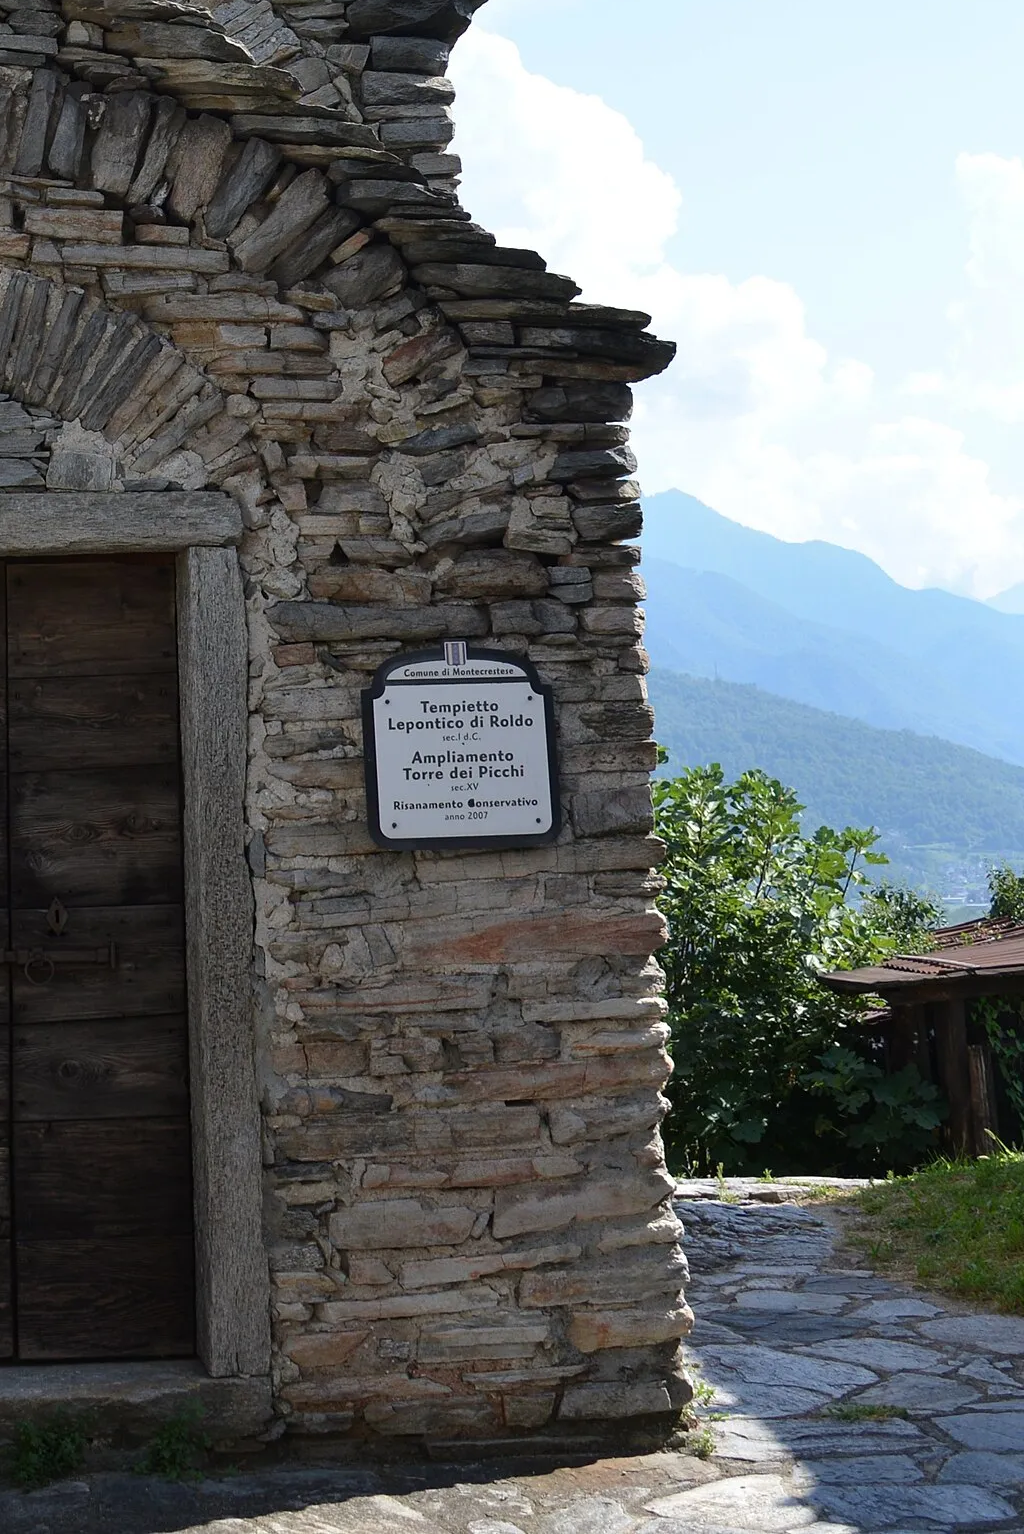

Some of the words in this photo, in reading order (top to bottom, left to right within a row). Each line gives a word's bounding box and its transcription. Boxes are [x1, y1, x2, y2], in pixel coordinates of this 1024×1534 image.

[404, 669, 439, 678] Comune
[442, 668, 450, 676] di
[452, 667, 514, 676] Montecrestese
[420, 700, 499, 717] Tempietto
[388, 717, 464, 734] Lepontico
[470, 715, 484, 728] di
[490, 714, 534, 727] Roldo
[464, 732, 482, 741] d.C.
[411, 750, 514, 767] Ampliamento
[402, 767, 444, 780] Torre
[449, 766, 473, 779] dei
[479, 765, 524, 778] Picchi
[451, 783, 479, 792] sec.XV
[393, 800, 464, 810] Risanamento
[444, 813, 465, 821] anno
[467, 811, 489, 820] 2007
